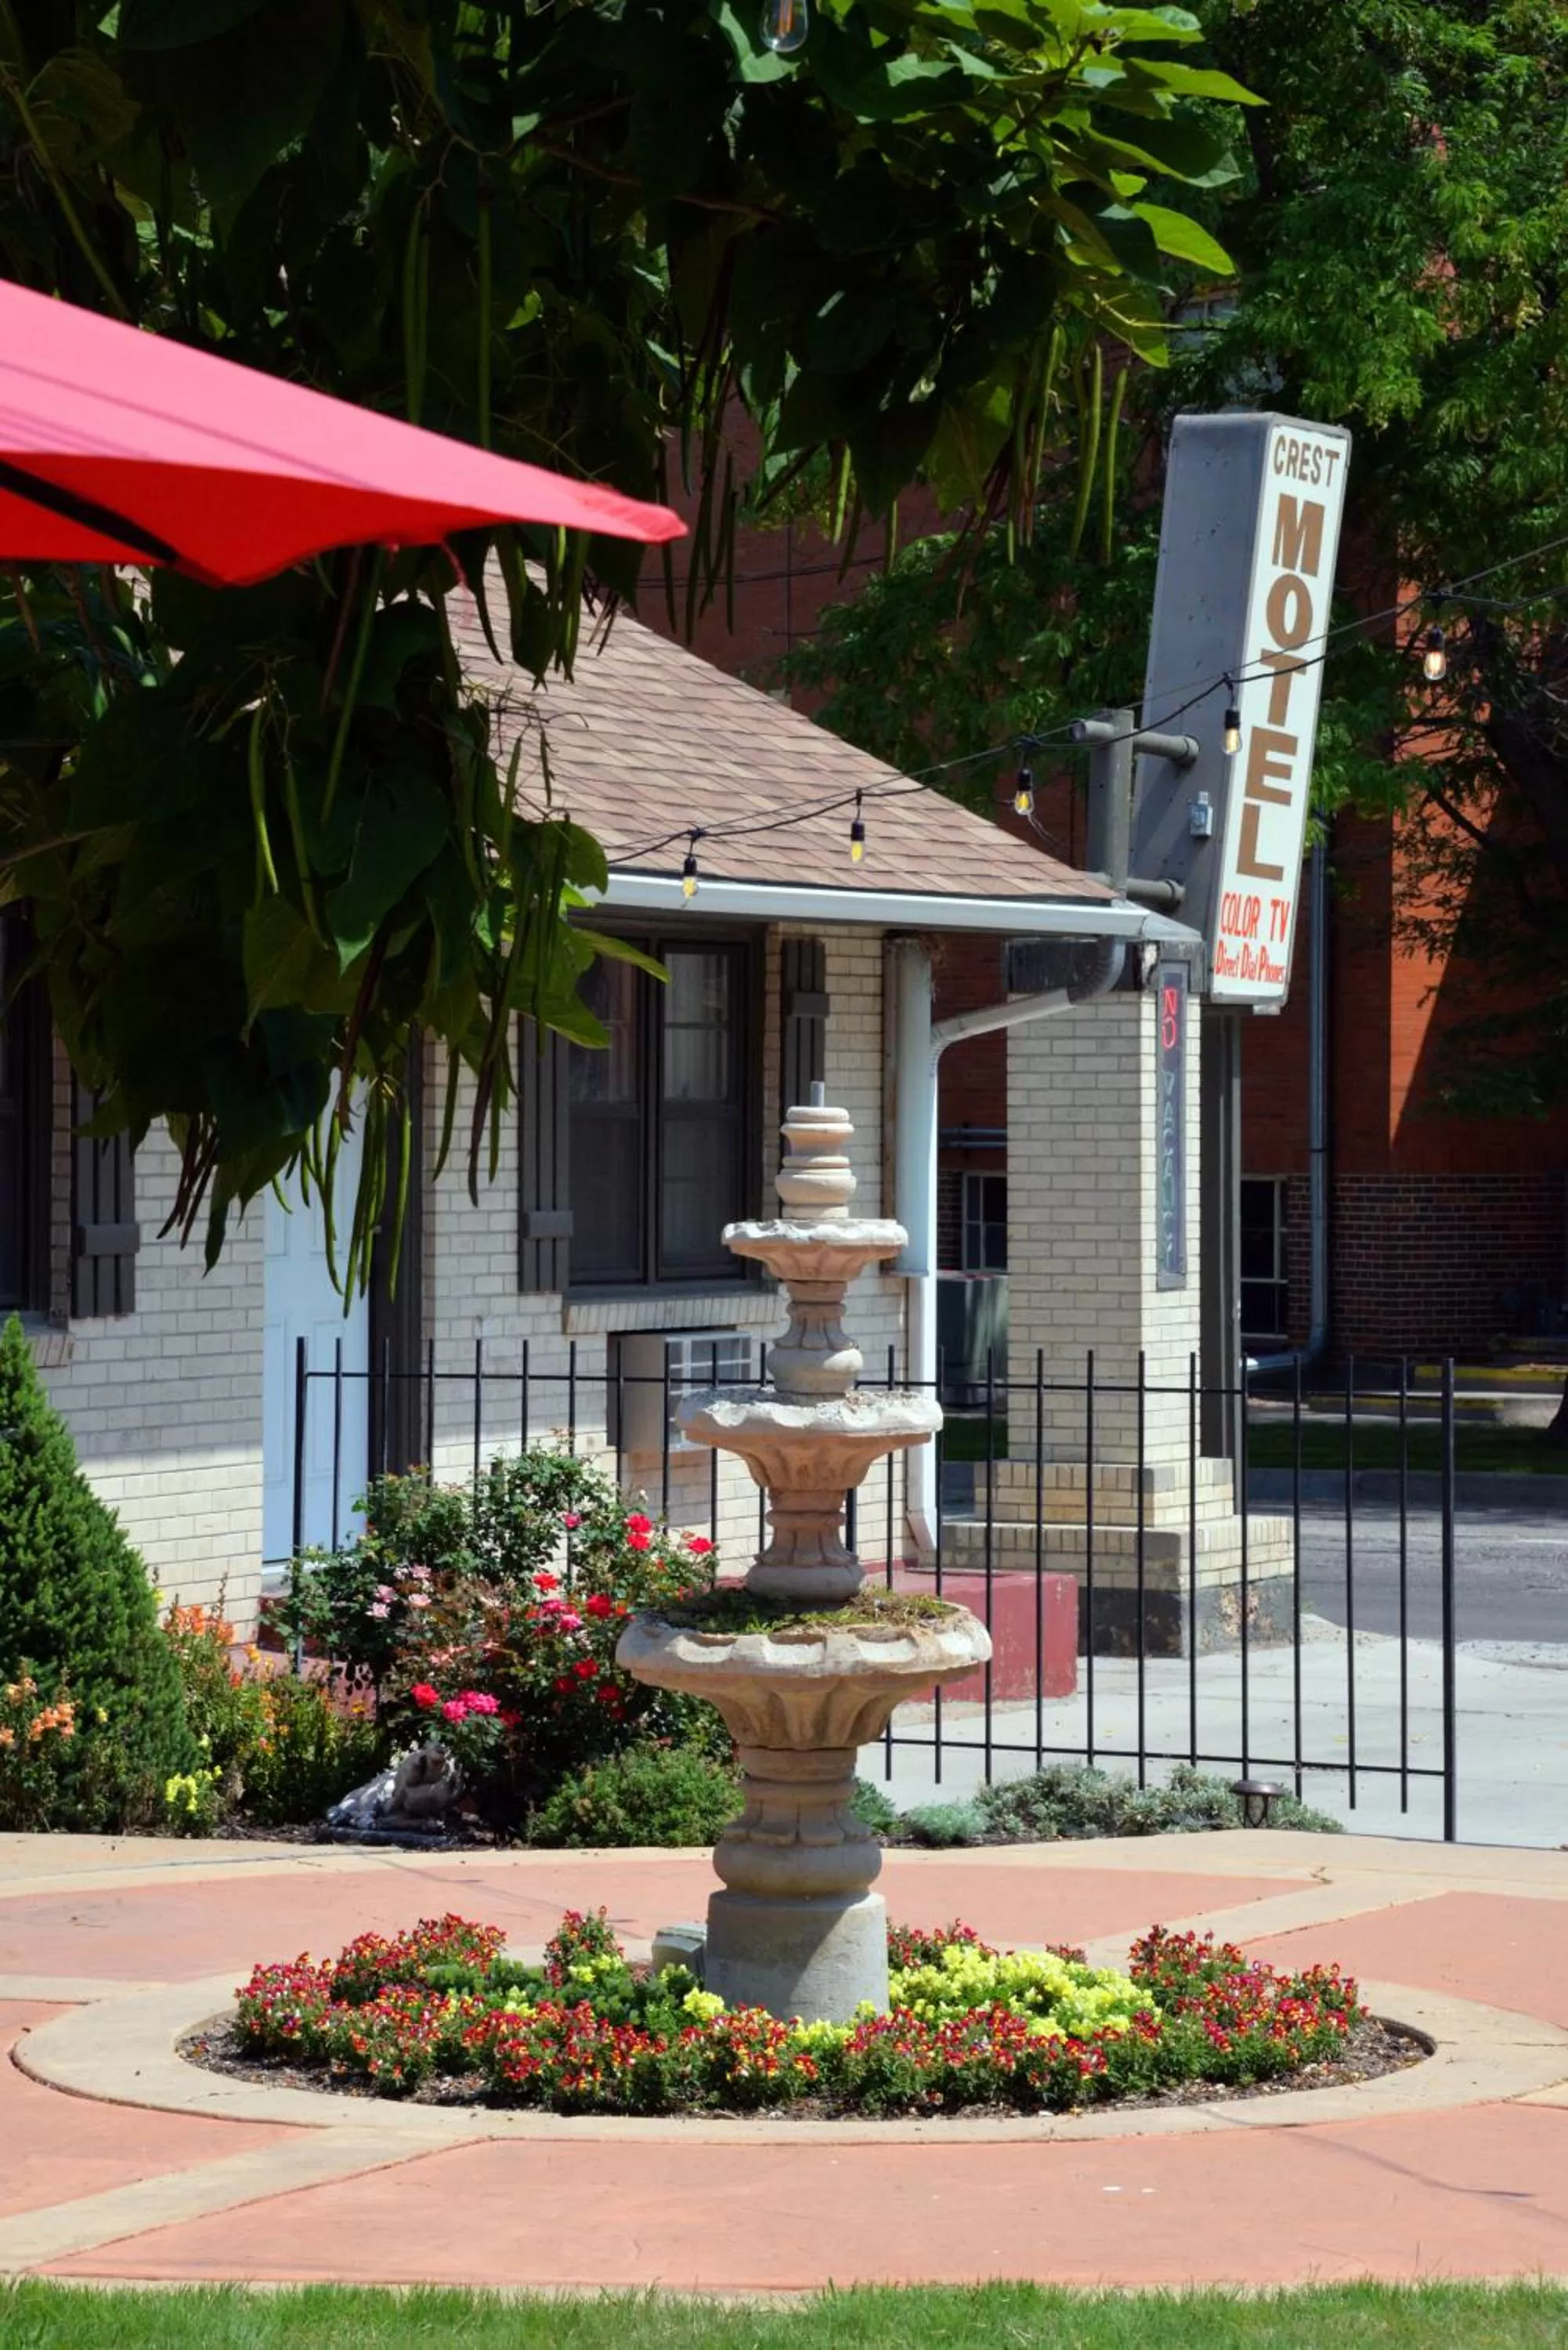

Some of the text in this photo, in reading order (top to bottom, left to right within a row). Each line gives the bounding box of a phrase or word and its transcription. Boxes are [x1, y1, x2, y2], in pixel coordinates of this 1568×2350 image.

[1273, 435, 1340, 487] CREST
[1236, 493, 1325, 881] MOTEL
[1220, 891, 1291, 943] COLOR TV
[1161, 987, 1178, 1050] NO
